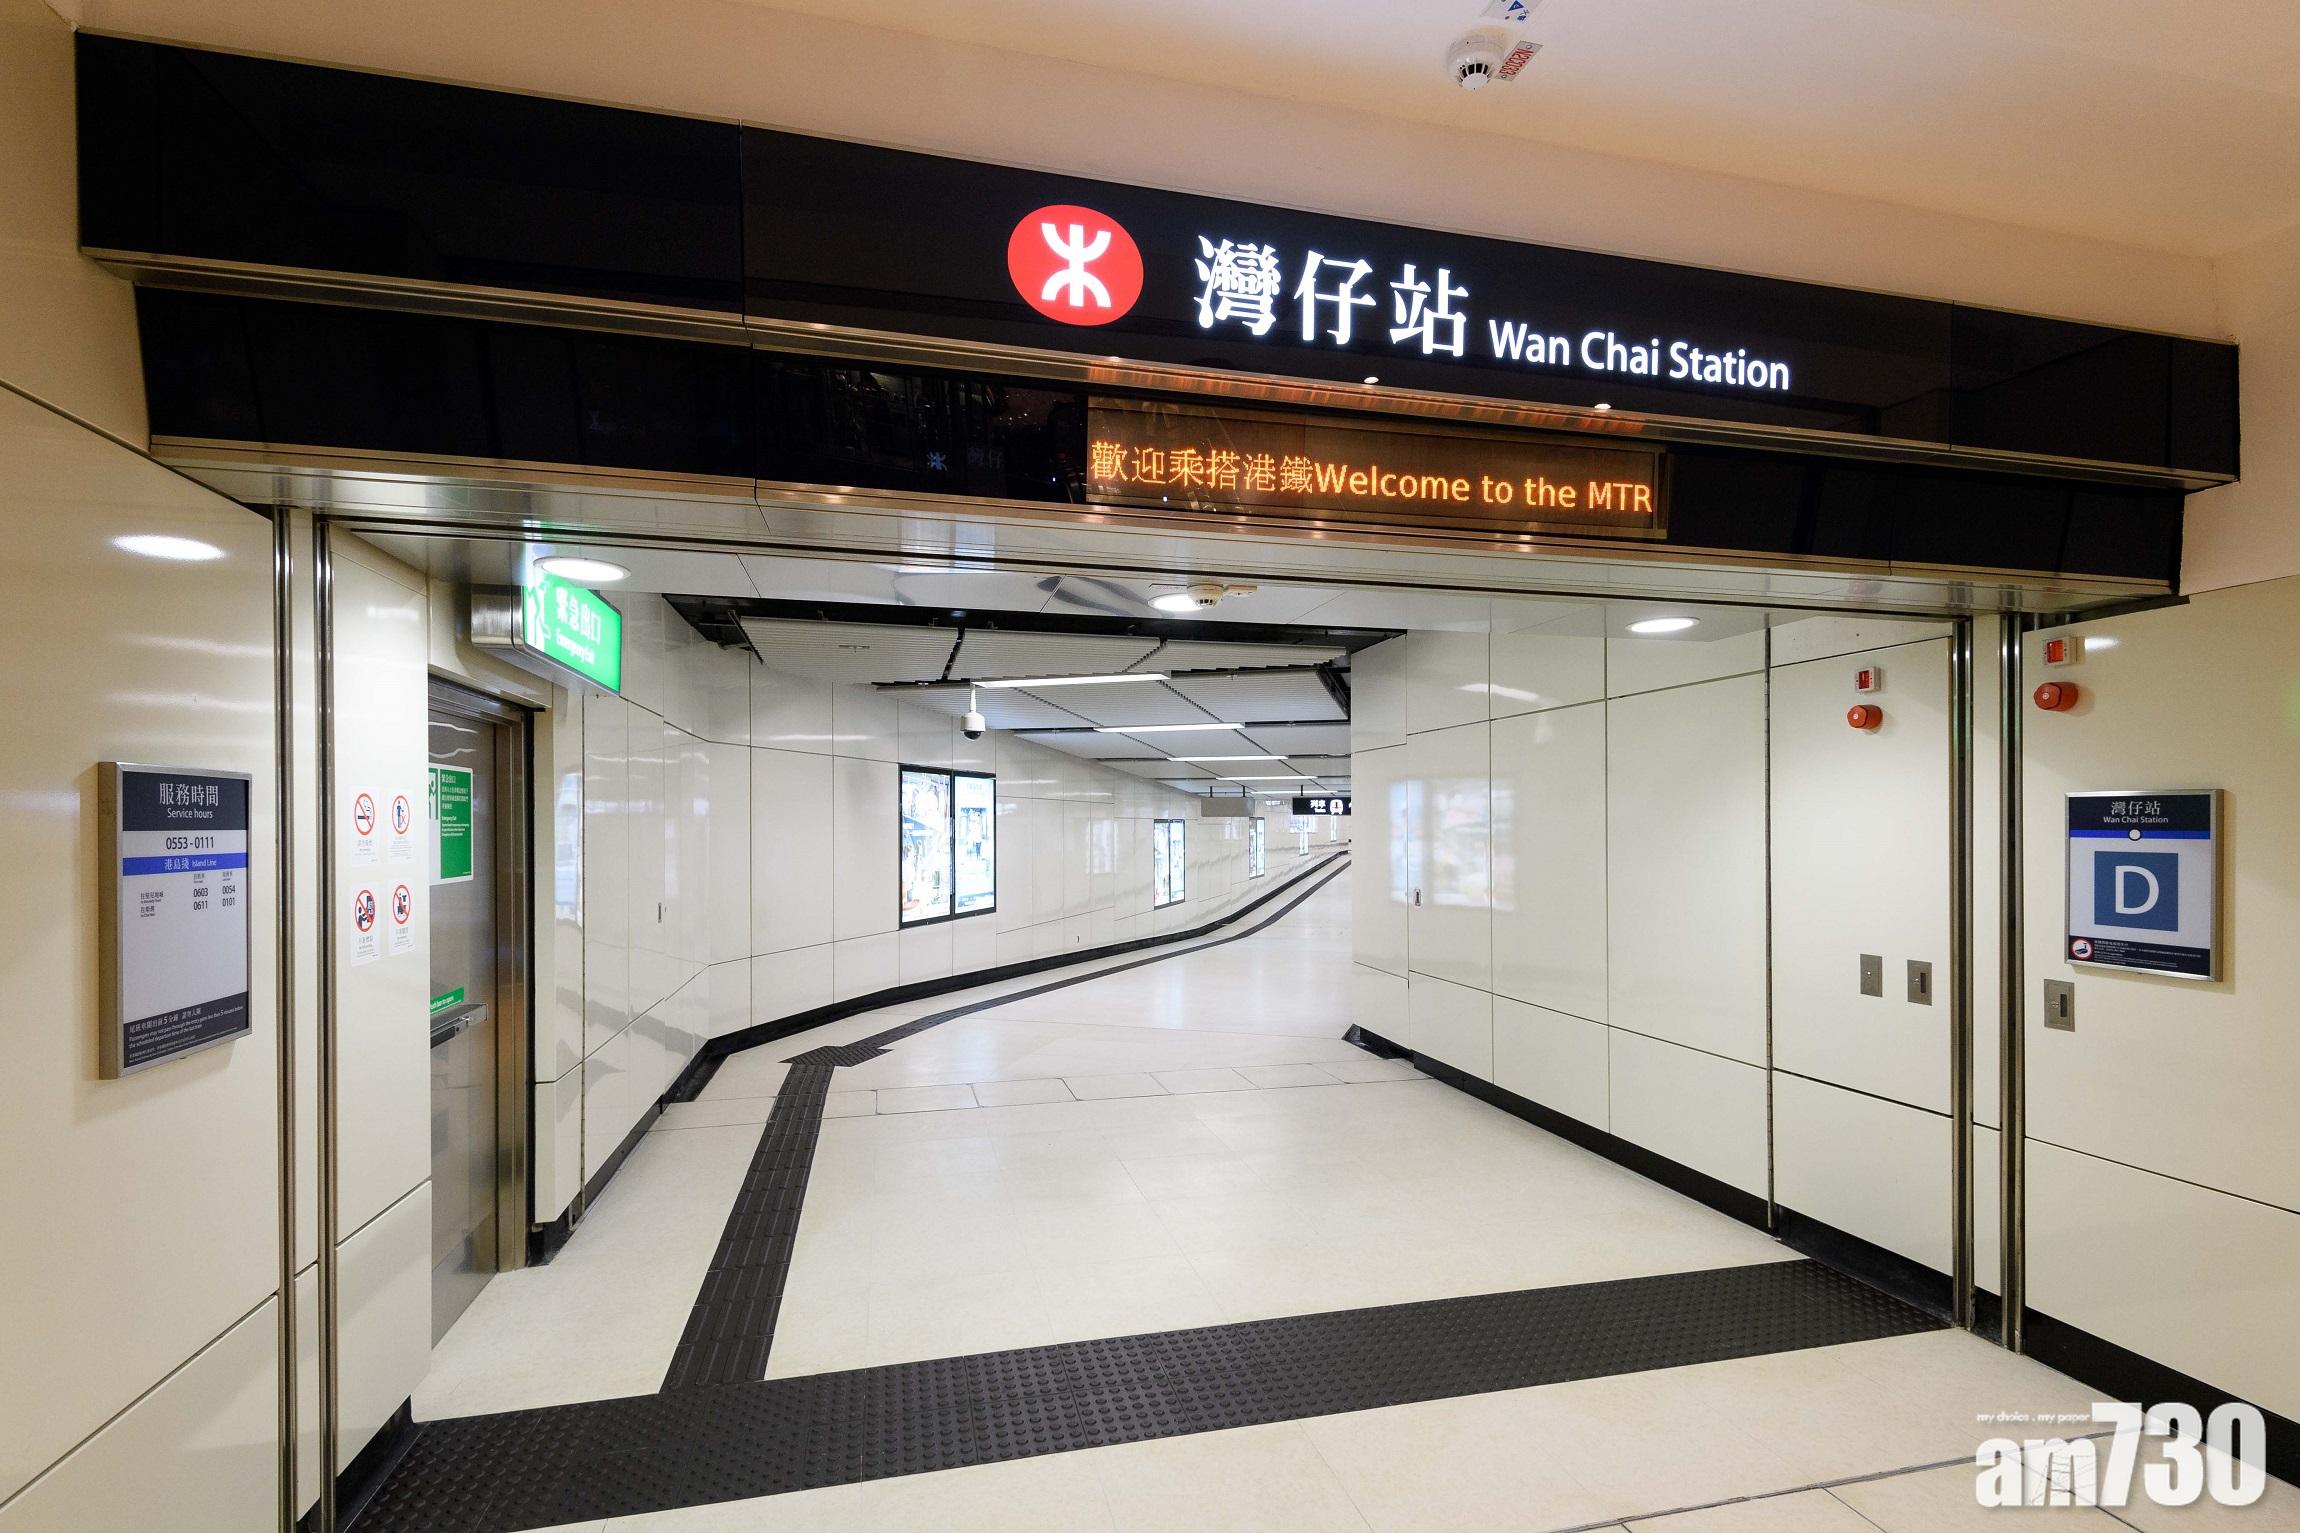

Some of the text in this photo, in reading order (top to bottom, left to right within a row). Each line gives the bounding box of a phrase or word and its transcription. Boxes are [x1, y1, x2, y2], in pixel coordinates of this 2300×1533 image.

[1193, 234, 1469, 357] 灣仔站
[1489, 319, 1789, 390] Wan Chai Station
[1481, 475, 1513, 504] to
[1524, 477, 1576, 508] the
[1588, 481, 1653, 513] MTR
[160, 782, 218, 806] 服務時間
[2111, 800, 2161, 815] 灣仔站
[167, 808, 213, 819] Service hours
[2140, 816, 2169, 824] Station
[2115, 865, 2160, 915] D
